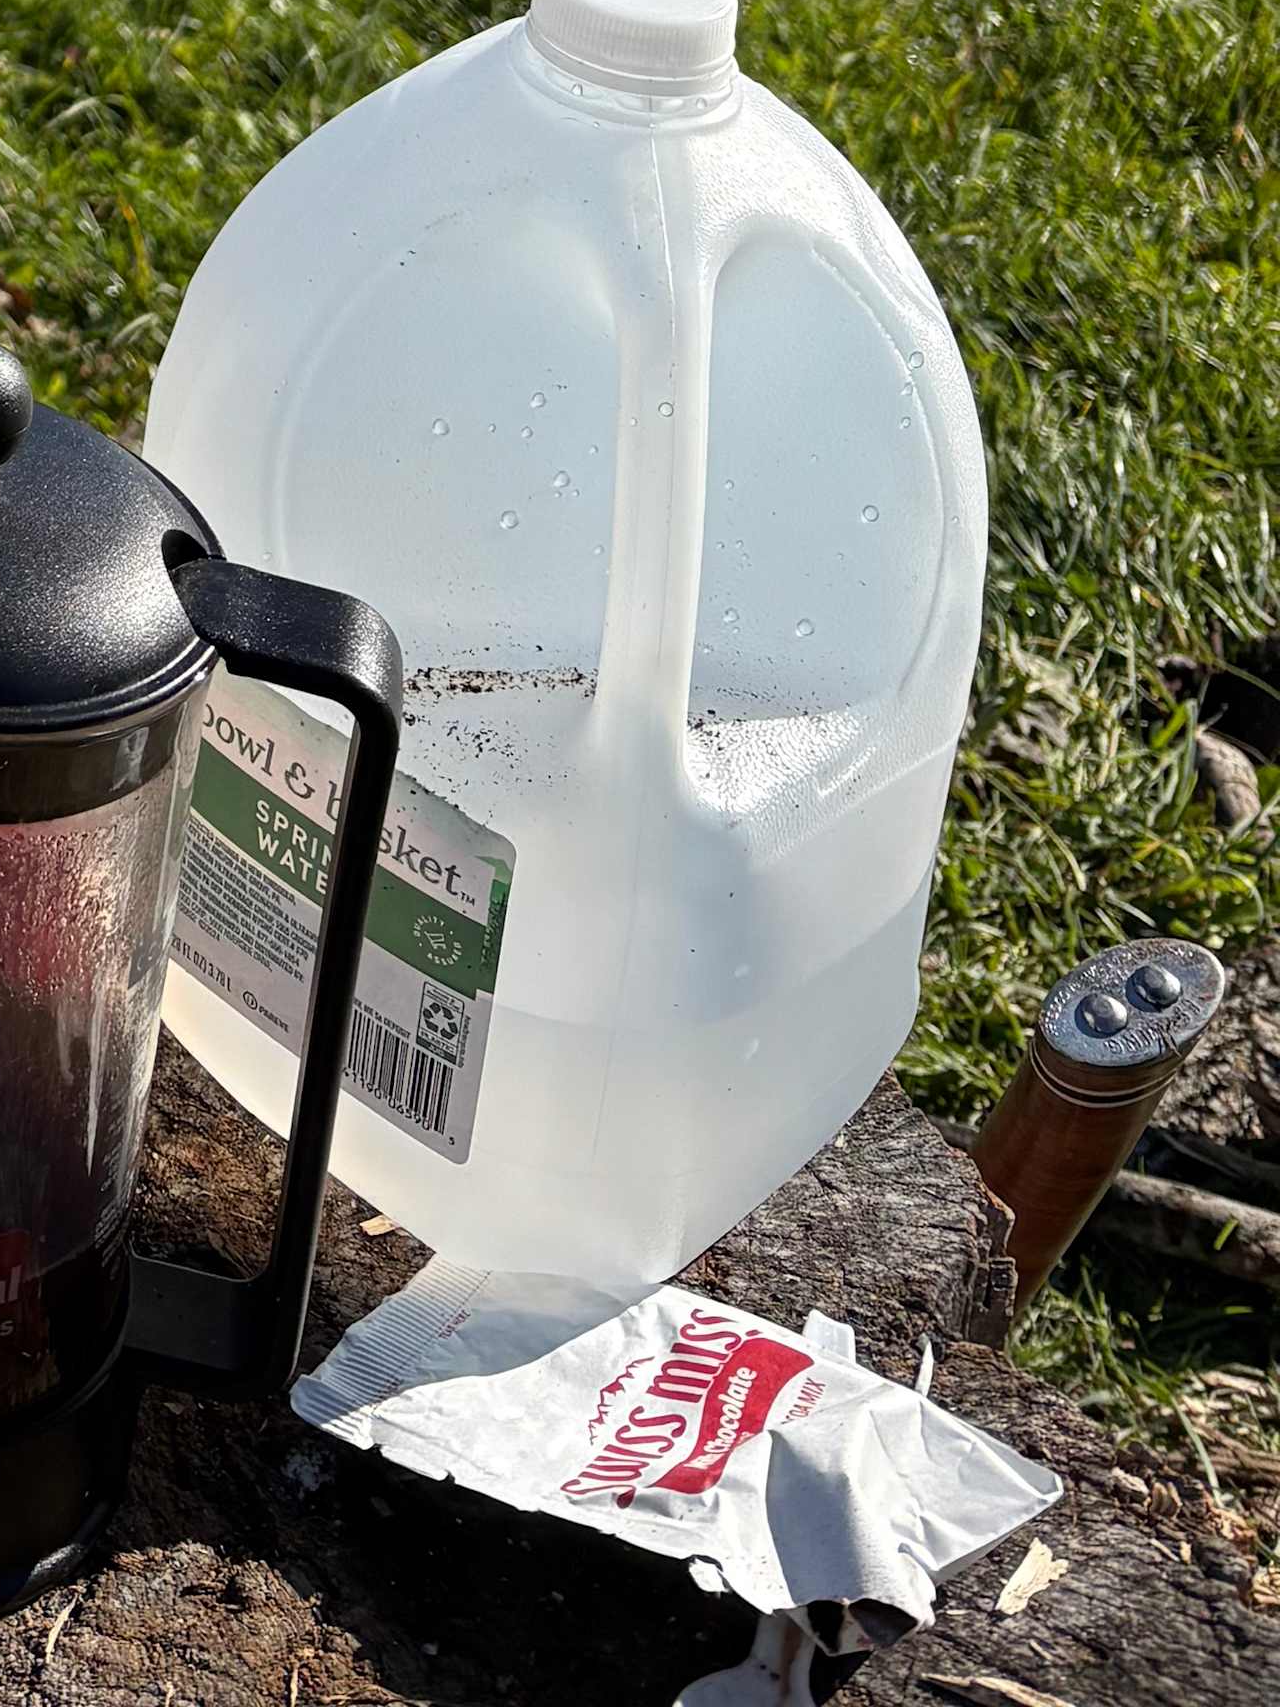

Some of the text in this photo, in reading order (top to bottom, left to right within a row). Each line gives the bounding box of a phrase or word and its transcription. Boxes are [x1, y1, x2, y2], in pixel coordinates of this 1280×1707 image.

[255, 799, 333, 868] SPRIN
[257, 826, 328, 896] WATE
[284, 762, 316, 800] &
[326, 780, 462, 897] bsket
[703, 1366, 758, 1454] Chocolate
